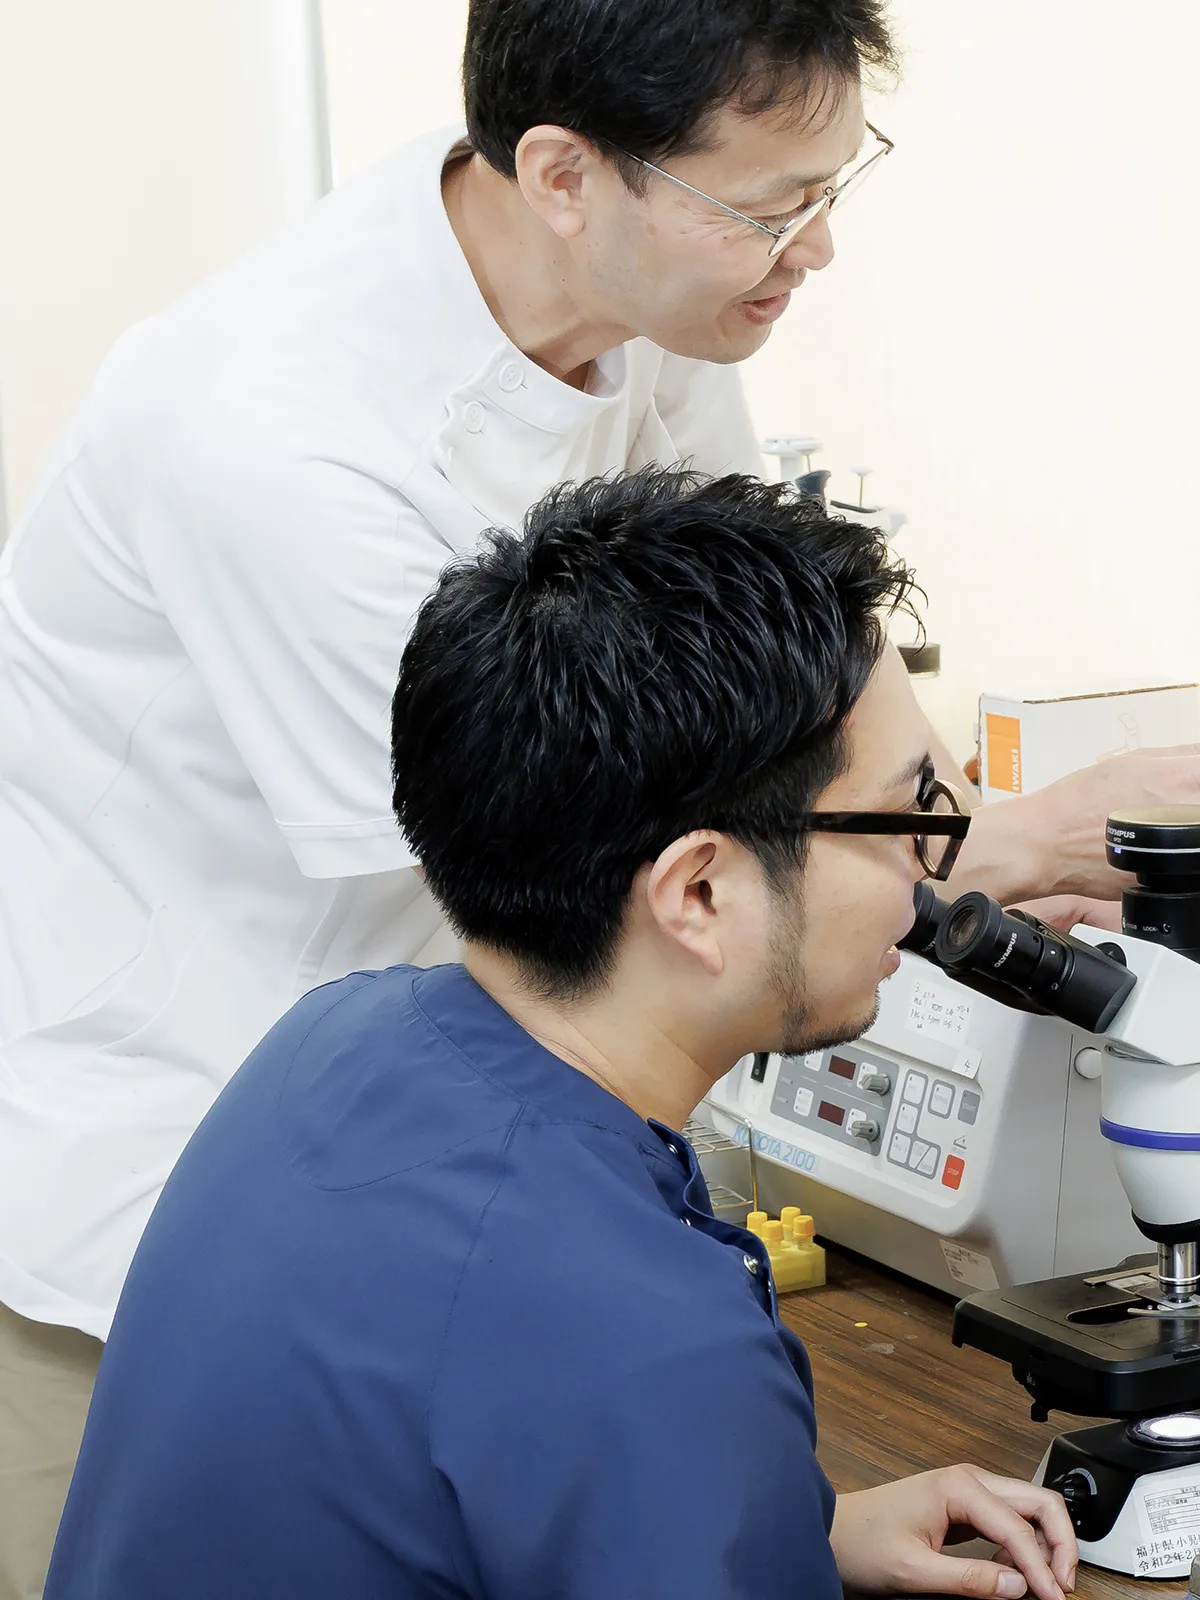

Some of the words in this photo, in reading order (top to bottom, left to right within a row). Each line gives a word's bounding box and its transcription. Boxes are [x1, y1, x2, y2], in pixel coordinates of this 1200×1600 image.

[1011, 748, 1019, 791] IWAKI
[1107, 826, 1135, 839] OLYMPUS
[994, 932, 1018, 968] OLYMPUS
[783, 1144, 816, 1173] 2100
